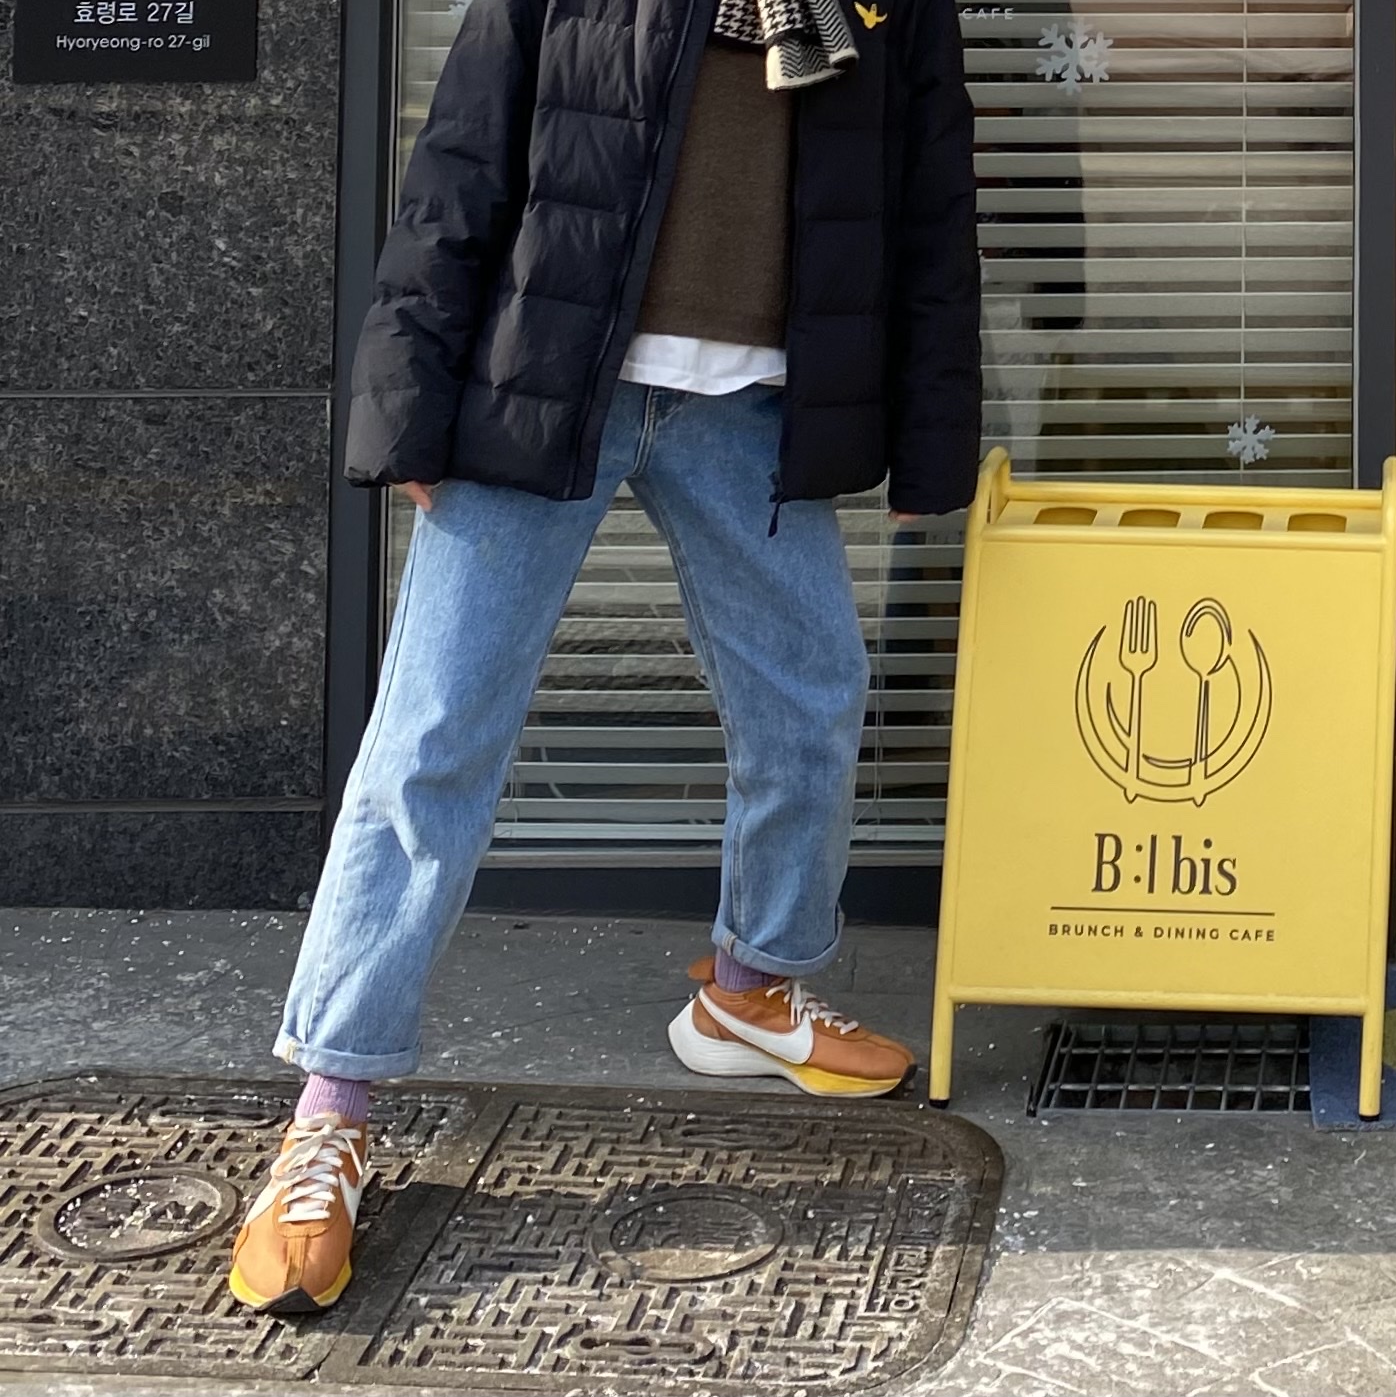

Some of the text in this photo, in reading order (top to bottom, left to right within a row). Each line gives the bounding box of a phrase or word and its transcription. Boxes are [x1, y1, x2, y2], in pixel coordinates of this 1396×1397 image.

[74, 1, 195, 25] 효령로 27길
[962, 7, 1014, 20] CAFE
[56, 35, 211, 51] Hyoryeong-ro 27-gil
[1171, 835, 1238, 896] bis
[1049, 924, 1276, 942] BRUNCH & DINING CAFE
